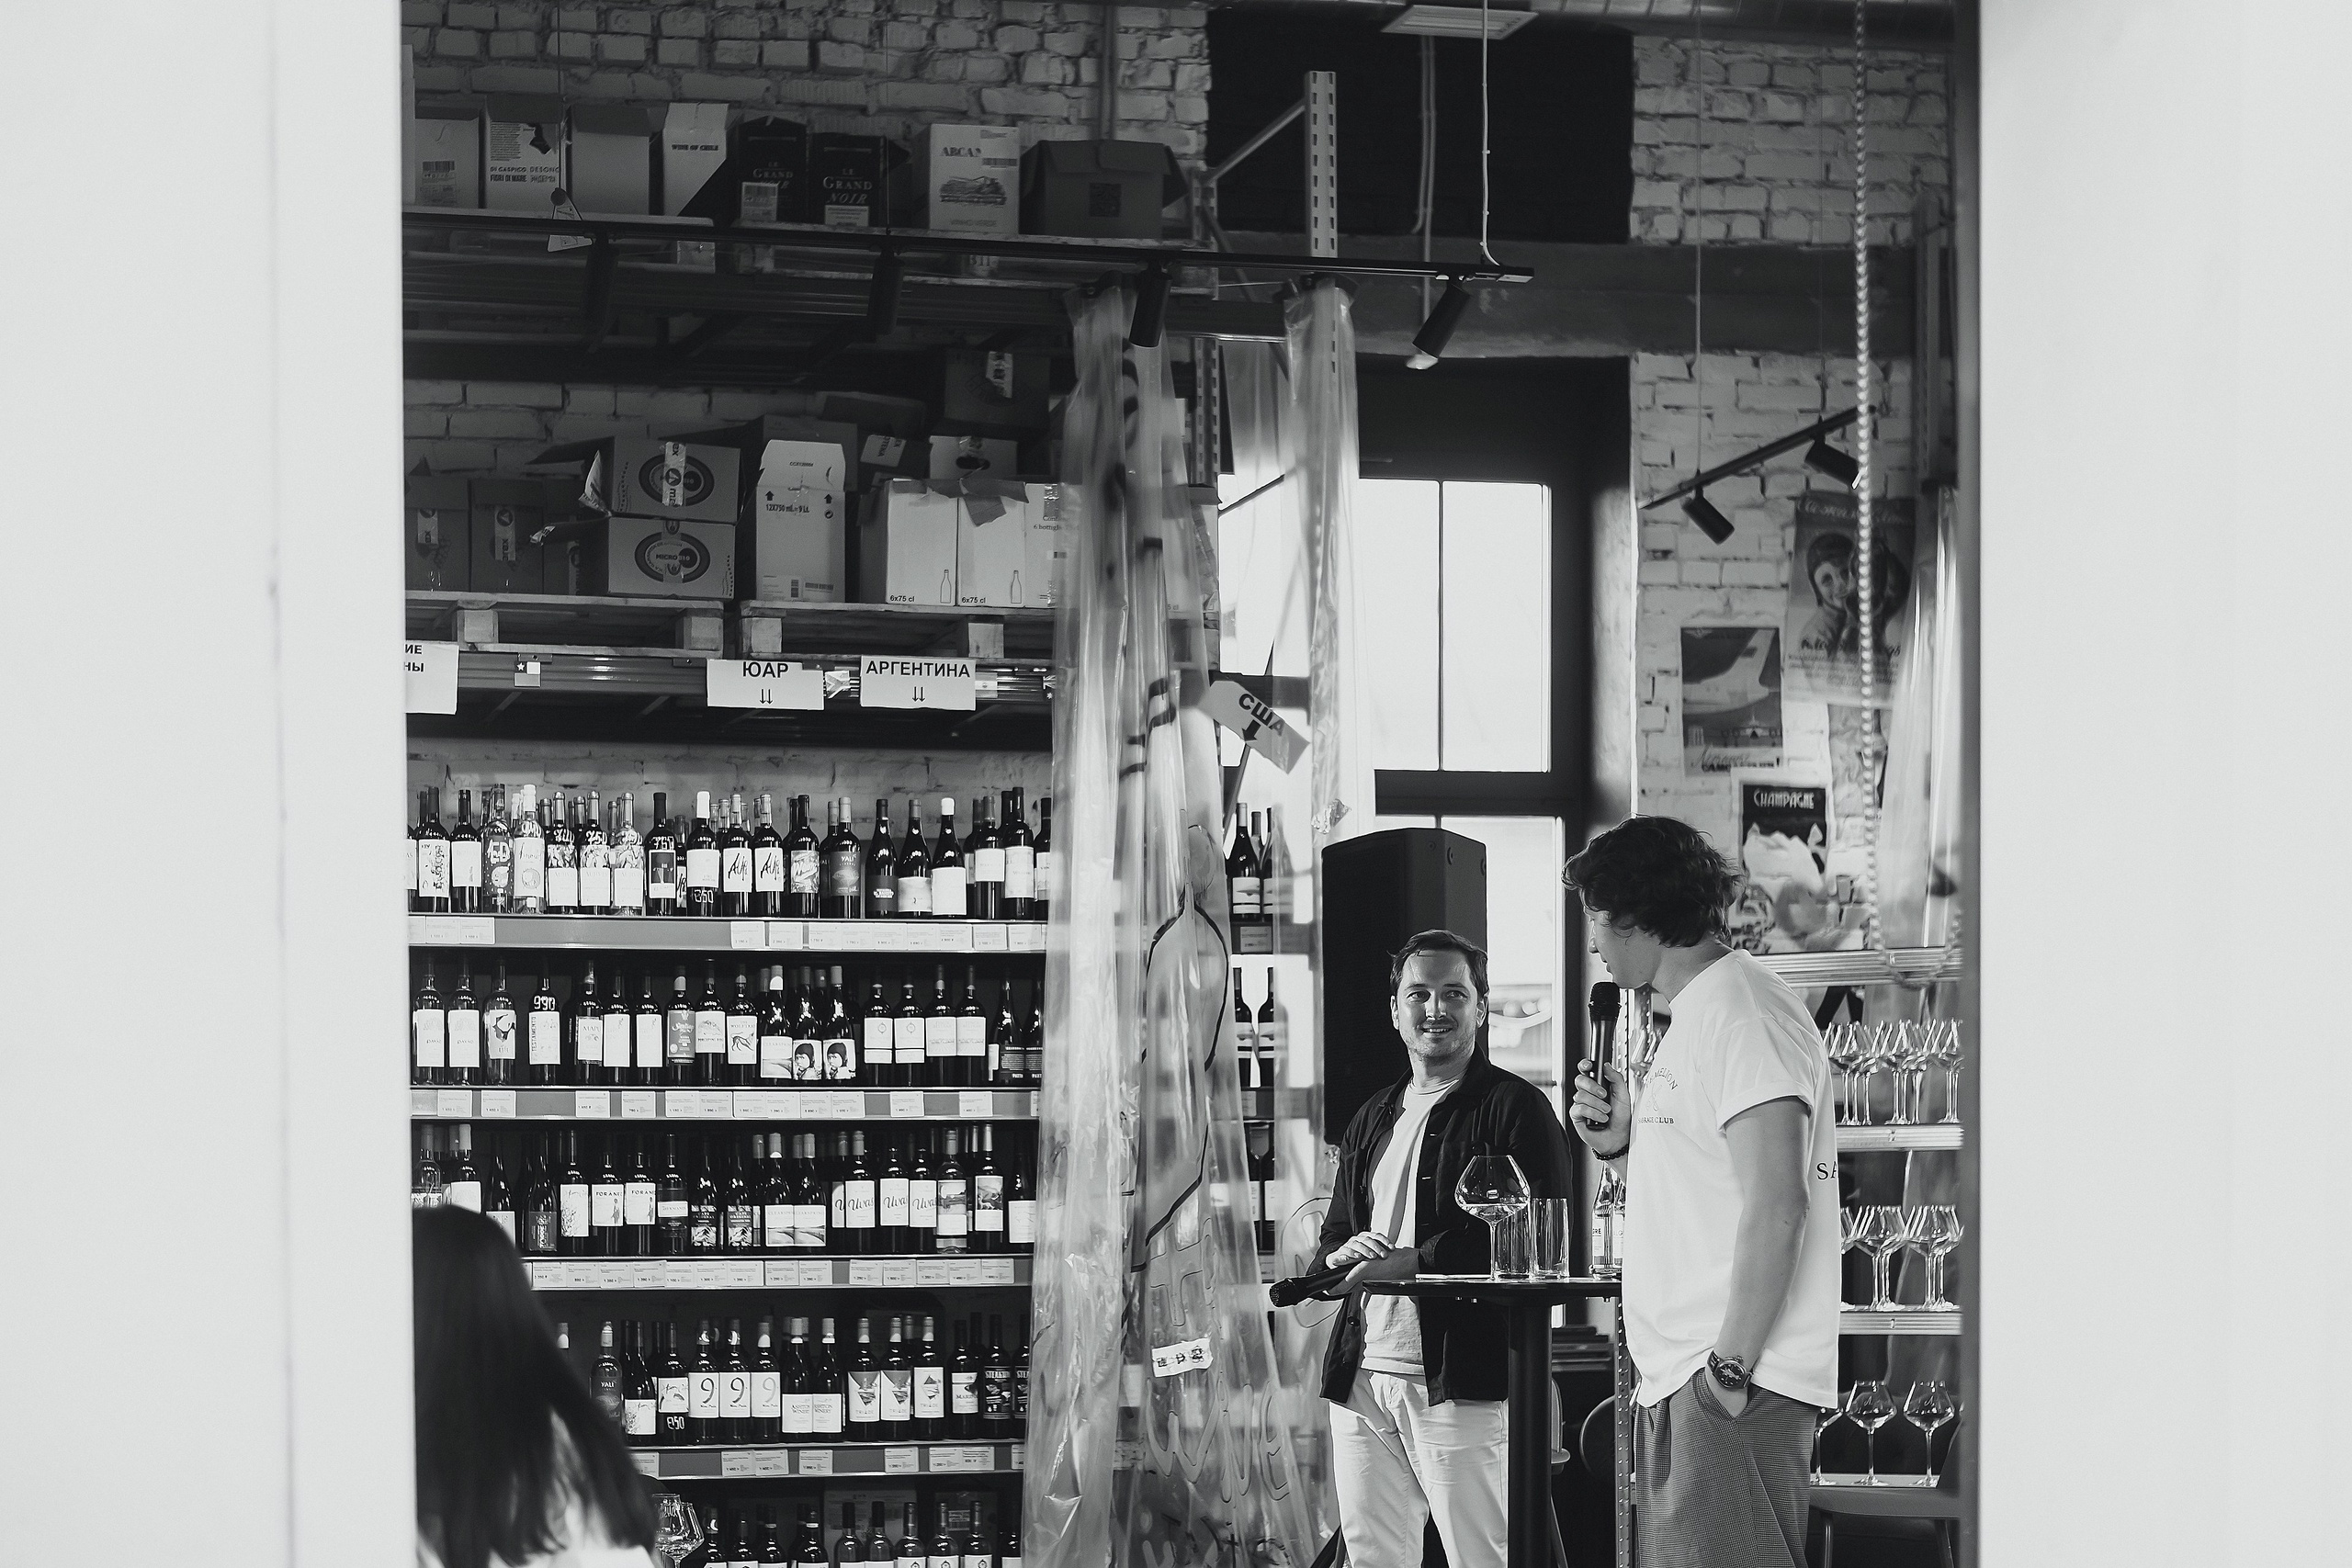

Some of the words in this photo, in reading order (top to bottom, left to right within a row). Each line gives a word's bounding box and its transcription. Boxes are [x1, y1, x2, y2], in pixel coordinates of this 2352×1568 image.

[752, 168, 794, 178] GRAND
[822, 175, 873, 190] GRAND
[827, 192, 868, 204] NOIR
[889, 594, 907, 603] 6x75
[741, 660, 789, 679] ЮАР
[865, 660, 970, 679] АРГЕНТИНА
[1238, 693, 1286, 737] США
[1753, 788, 1815, 811] CHAMPAGNE
[700, 1377, 716, 1404] 9
[730, 1377, 746, 1404] 9
[763, 1377, 778, 1404] 9
